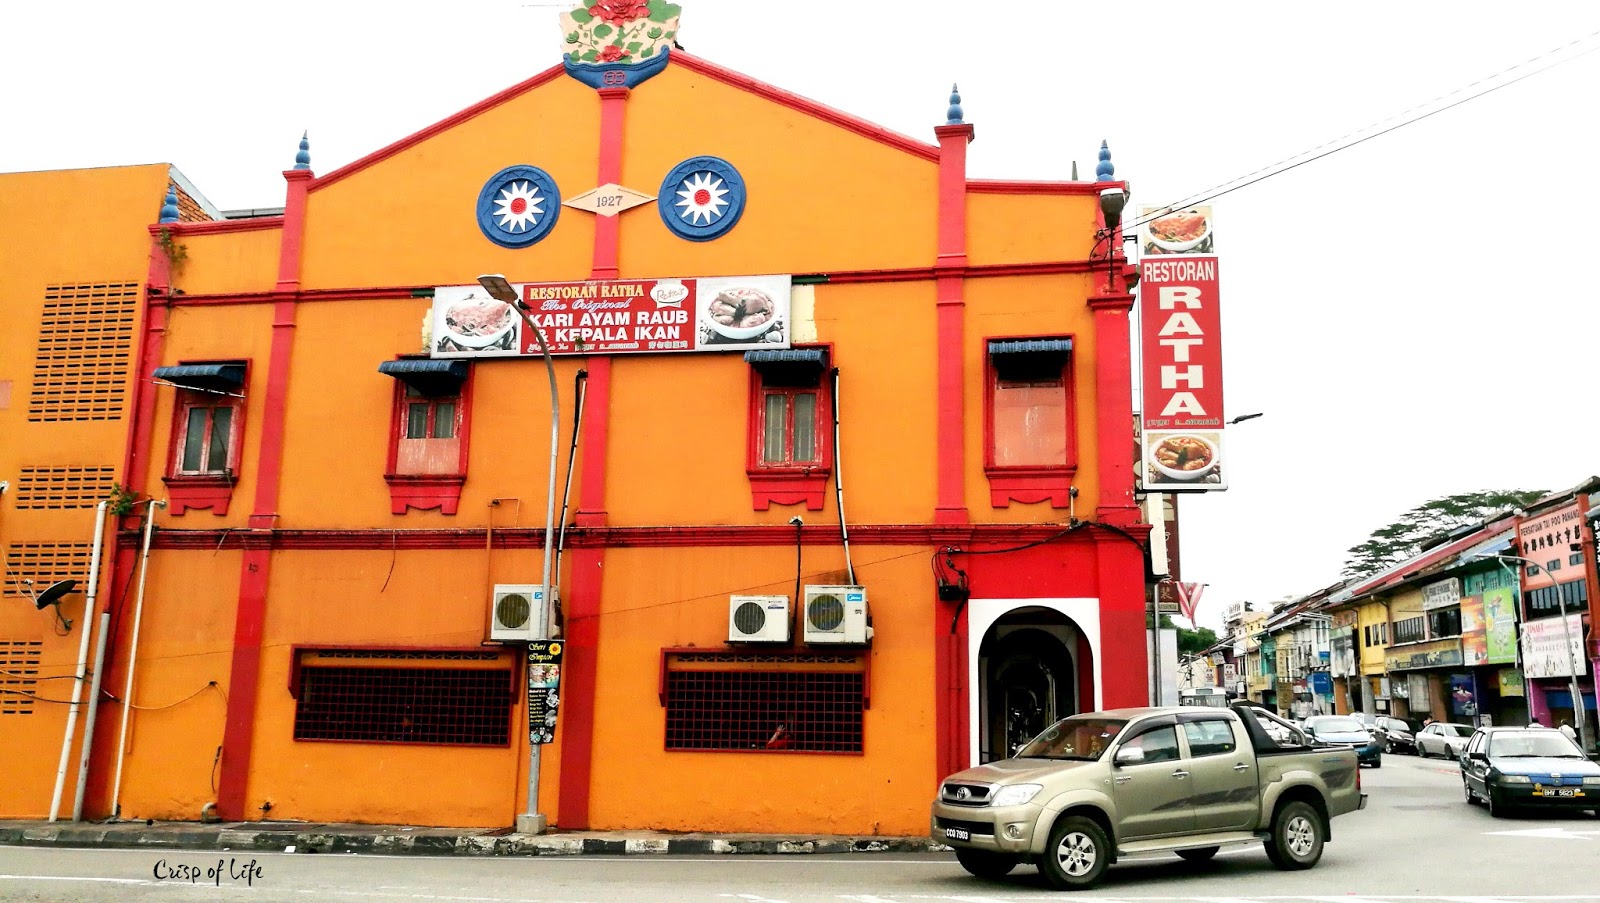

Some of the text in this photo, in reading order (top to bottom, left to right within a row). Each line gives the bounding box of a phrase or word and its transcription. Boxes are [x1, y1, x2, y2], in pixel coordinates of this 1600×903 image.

[596, 195, 624, 208] 1927
[1143, 261, 1215, 283] RESTORAN
[529, 284, 645, 300] RESTORAN RATHA
[540, 298, 634, 313] The Original
[529, 310, 689, 328] KARI AYAM RAUB
[555, 327, 629, 343] KEPALA
[634, 325, 681, 340] IKAN
[1157, 286, 1208, 416] RATHA
[956, 829, 968, 840] 7903
